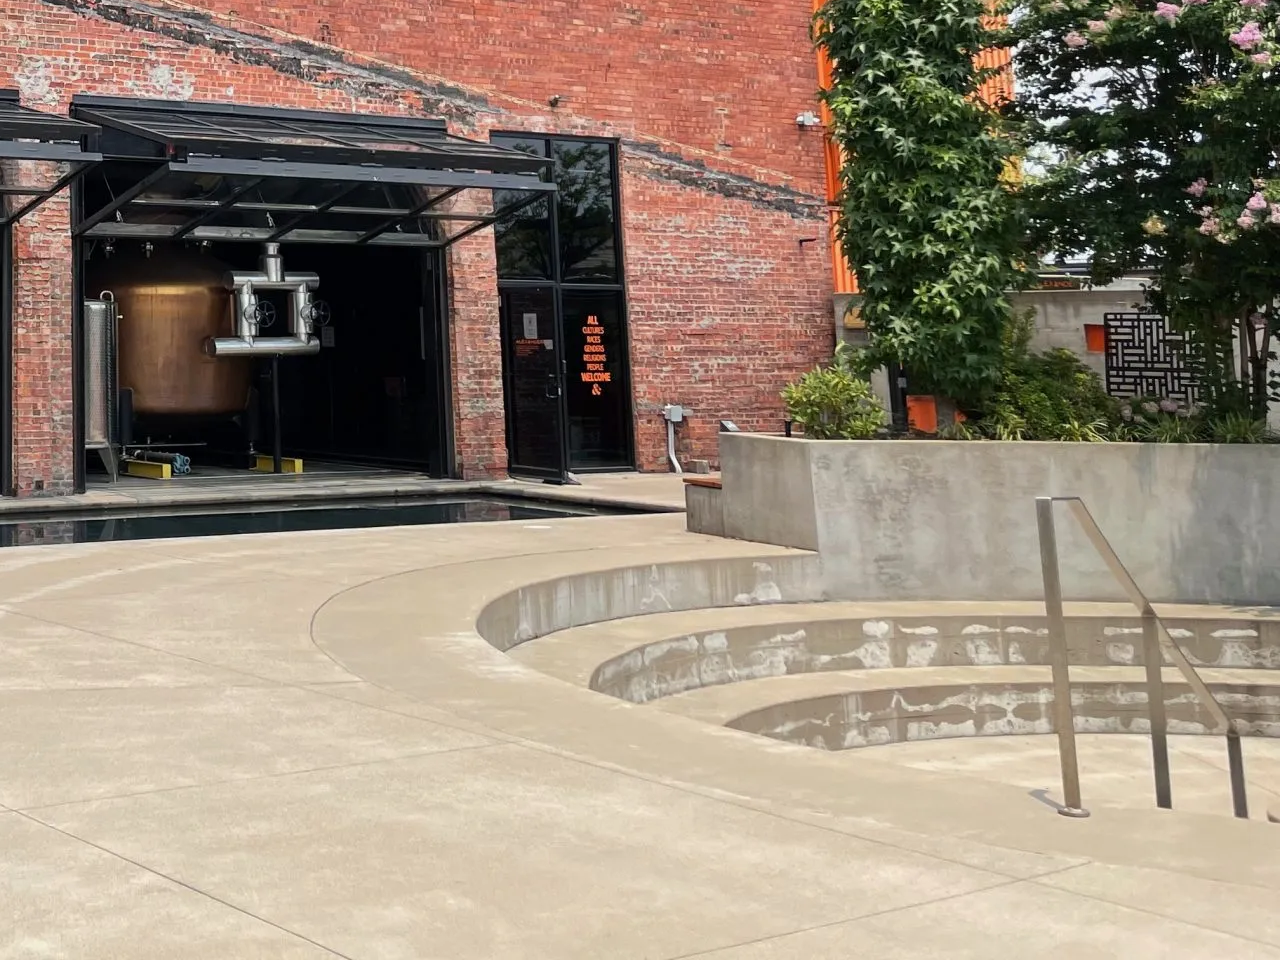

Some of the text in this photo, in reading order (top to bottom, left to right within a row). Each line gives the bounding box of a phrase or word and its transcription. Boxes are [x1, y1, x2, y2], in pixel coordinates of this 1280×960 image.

[587, 315, 599, 325] ALL
[586, 363, 604, 371] PEOPLE
[581, 372, 611, 382] WELCOME
